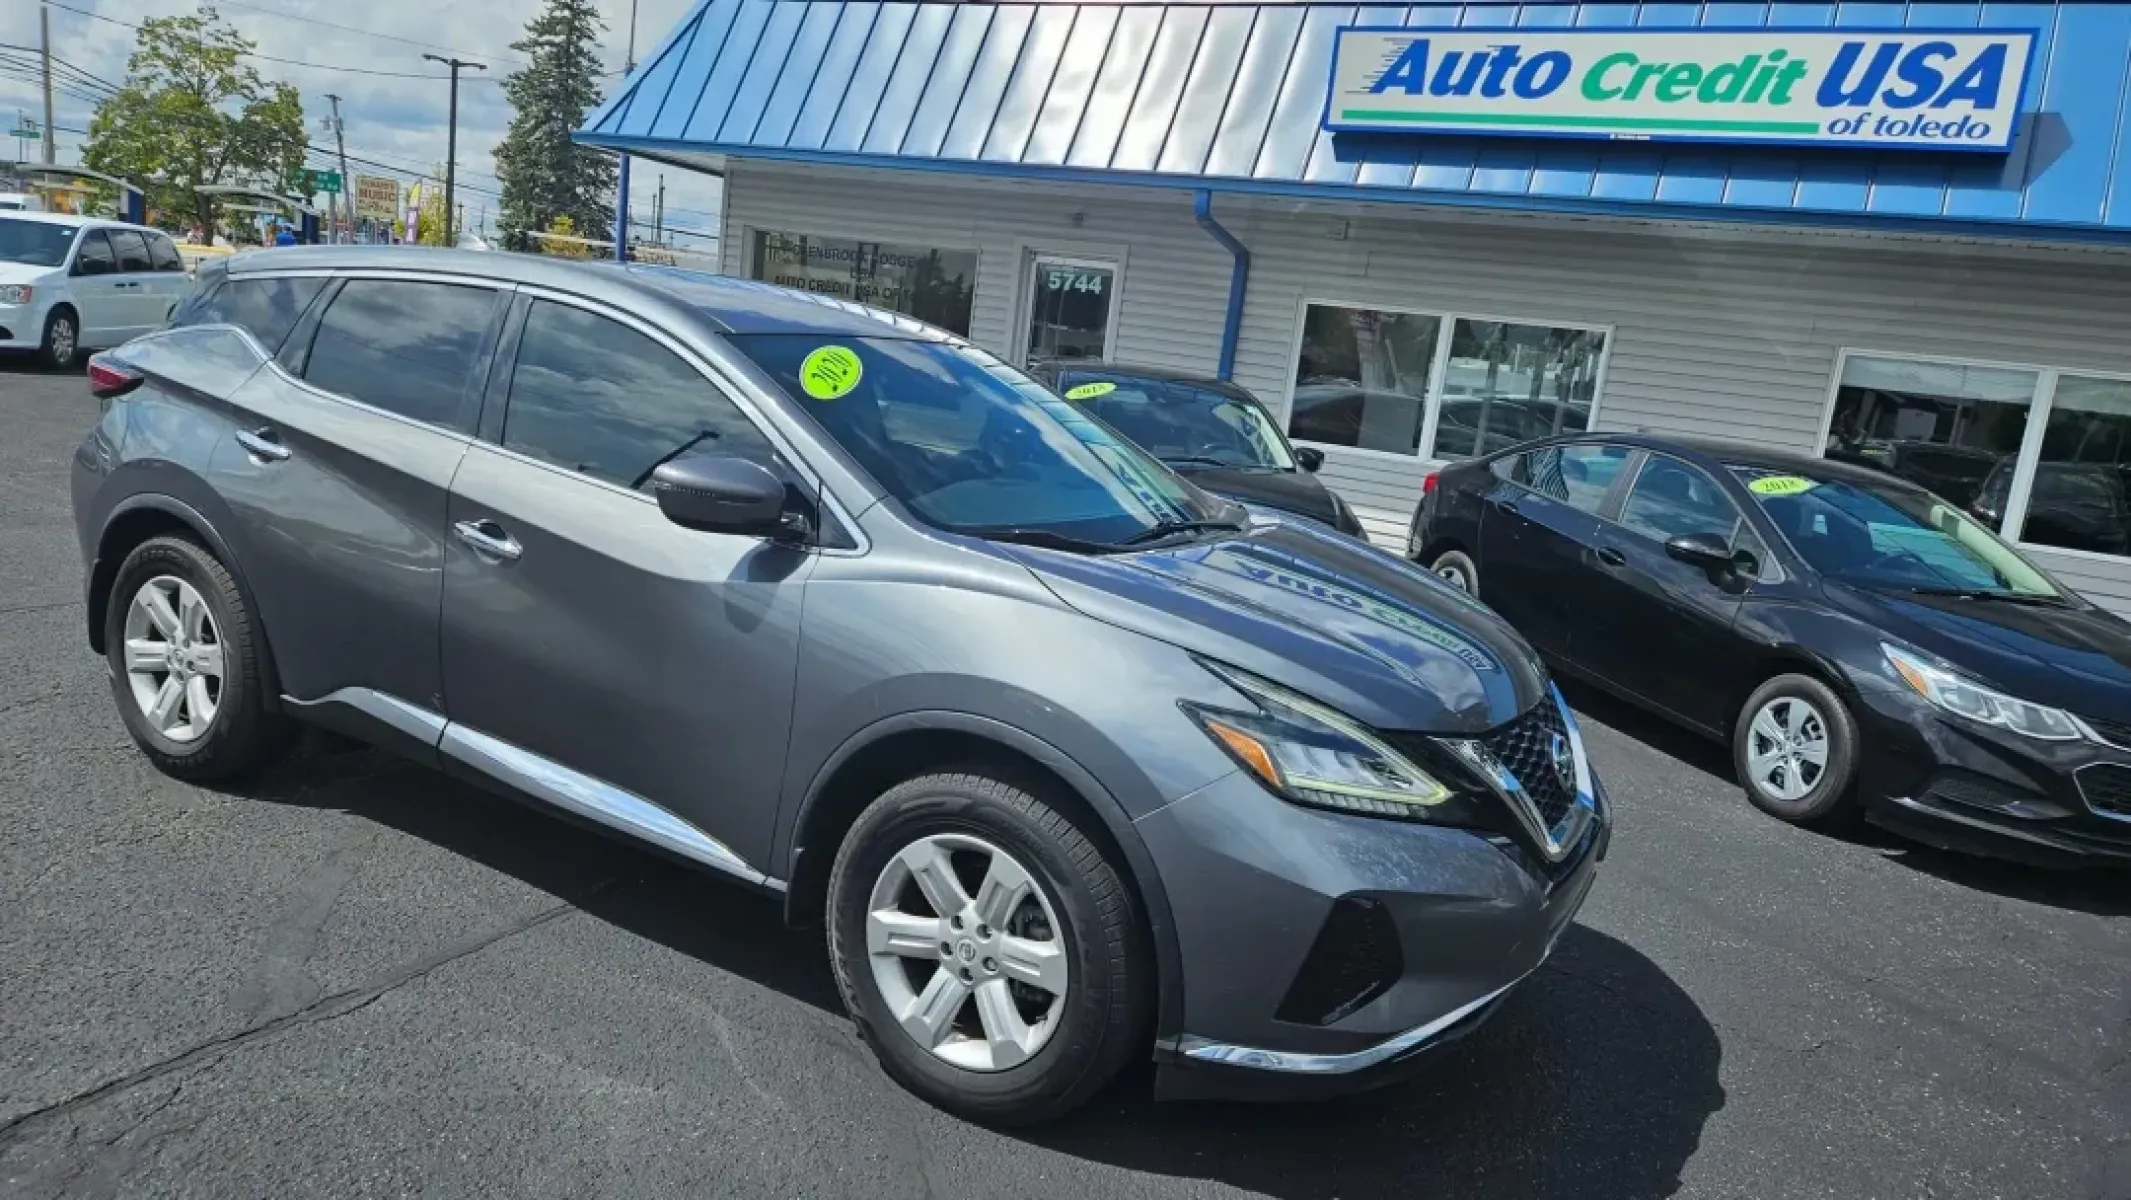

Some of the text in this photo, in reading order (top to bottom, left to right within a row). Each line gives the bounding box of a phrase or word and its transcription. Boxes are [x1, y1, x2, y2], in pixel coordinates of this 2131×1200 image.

[1368, 38, 2009, 109] Auto Credit USA
[1826, 111, 1991, 139] of toledo
[1047, 271, 1102, 295] 5744
[810, 350, 853, 393] 2020
